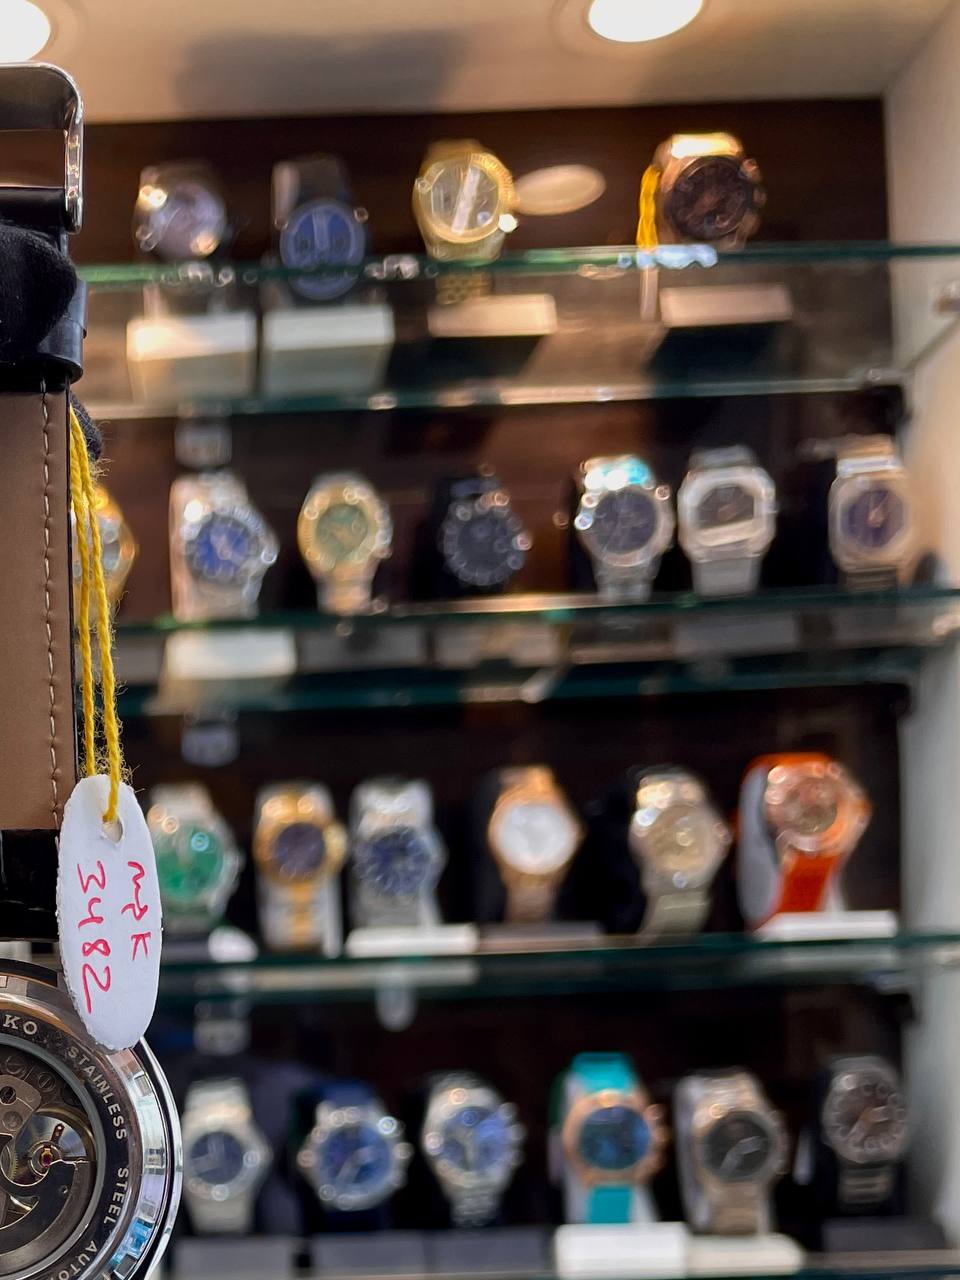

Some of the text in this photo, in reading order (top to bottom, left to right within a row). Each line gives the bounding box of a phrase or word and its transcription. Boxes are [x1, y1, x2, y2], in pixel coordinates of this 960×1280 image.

[77, 860, 112, 1014] 3482
[67, 1046, 128, 1141] STAINLESS
[103, 1167, 130, 1226] STEEL
